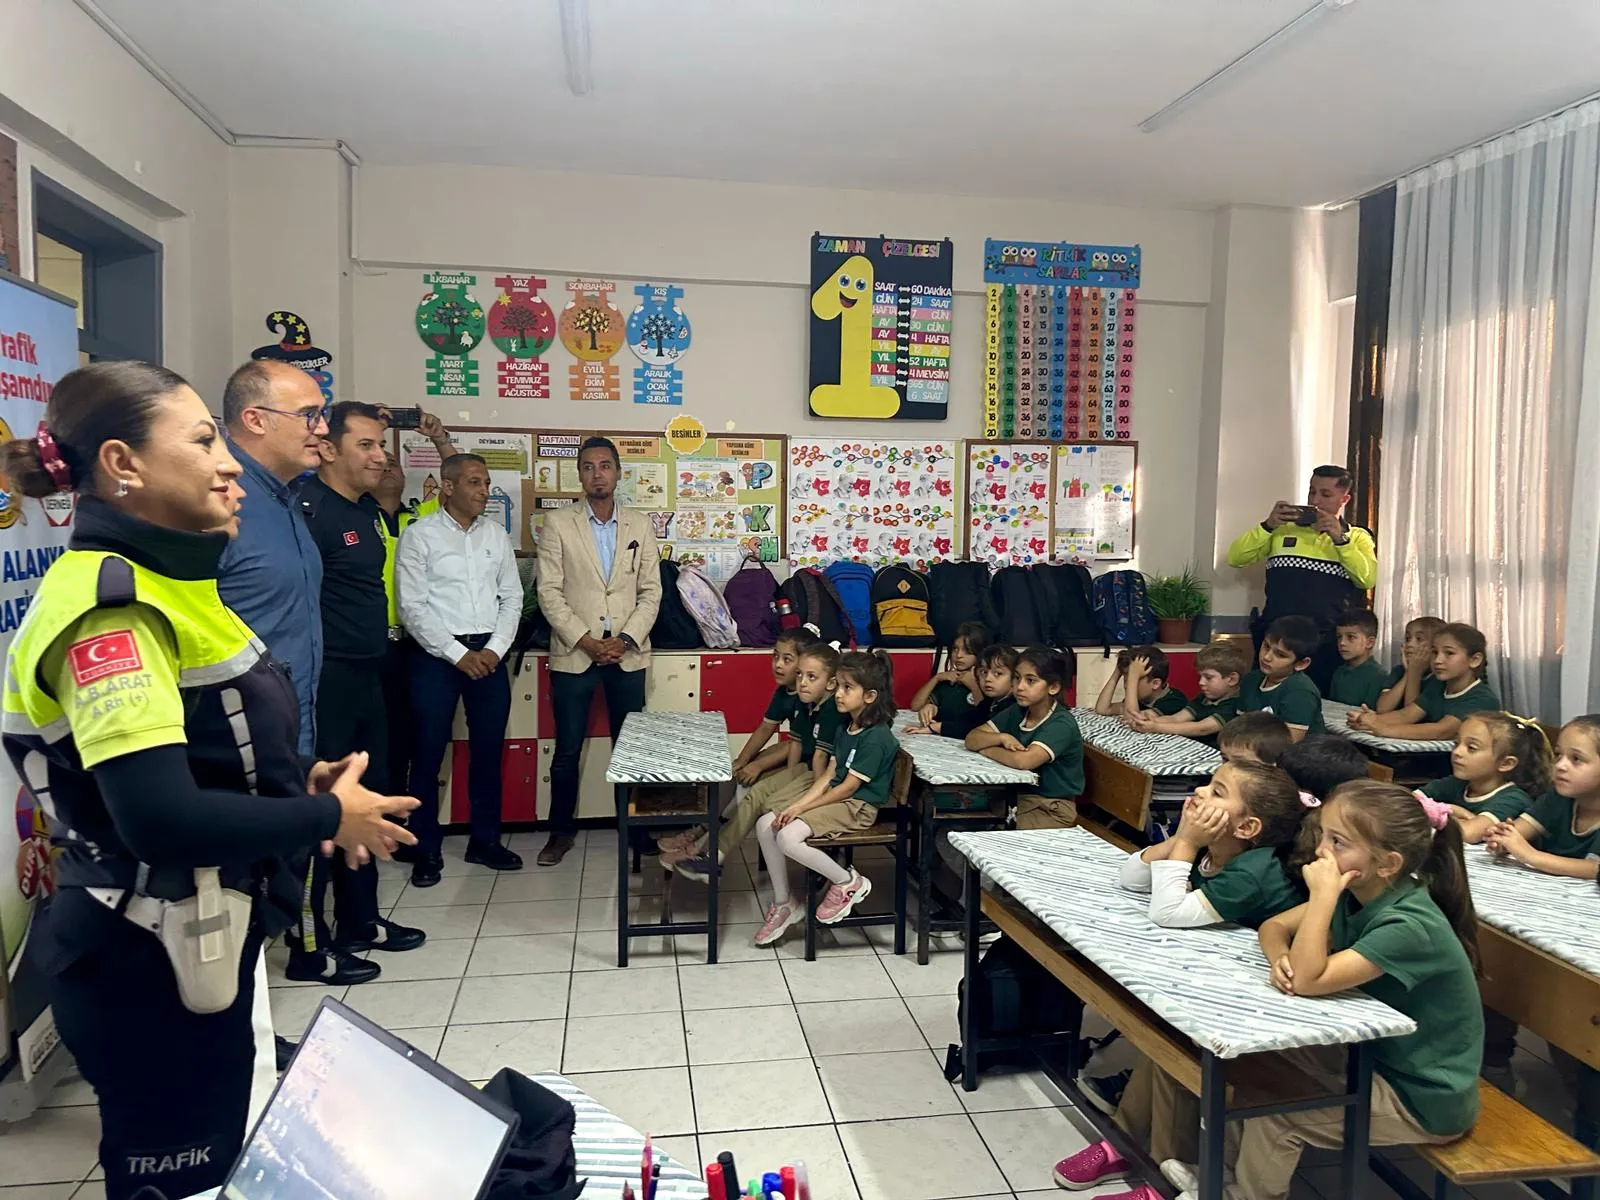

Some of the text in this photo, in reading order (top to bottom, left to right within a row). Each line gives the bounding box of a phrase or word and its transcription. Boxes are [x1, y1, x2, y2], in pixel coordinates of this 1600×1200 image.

[818, 239, 940, 258] ZAMAN ÇİZELGESİ
[430, 274, 470, 285] İLKBAHAR
[512, 279, 529, 288] YAZ
[568, 282, 613, 291] SONBAHAR
[875, 282, 952, 296] SAAT 60 DAKİKA
[992, 289, 996, 297] 2
[1110, 292, 1115, 300] 9
[876, 294, 950, 308] GÜN 24 SAAT
[873, 305, 897, 315] HAFTA
[912, 310, 917, 318] 7
[991, 304, 996, 312] 4
[1024, 305, 1029, 313] 8
[1109, 308, 1115, 316] 18
[879, 318, 891, 327] AY
[927, 322, 944, 332] GÜN
[991, 320, 996, 328] 6
[1040, 321, 1046, 329] 15
[1107, 323, 1115, 331] 27
[1124, 324, 1133, 332] 30
[878, 329, 949, 344] AY 4 HAFTA
[1090, 339, 1098, 347] 32
[1106, 339, 1115, 347] 36
[878, 352, 947, 367] YIL 52 HAFTA
[989, 352, 996, 360] 10
[1039, 352, 1047, 360] 25
[1106, 354, 1115, 362] 45
[440, 360, 464, 369] MART
[506, 361, 542, 372] HAZİRAN
[583, 365, 606, 374] EYLÜL
[440, 372, 465, 382] NİSAN
[644, 369, 672, 378] ARALIK
[877, 364, 949, 380] YIL 4 MEVSİM
[1105, 370, 1114, 378] 54
[505, 376, 542, 385] TEMMUZ
[585, 377, 605, 387] EKİM
[909, 380, 924, 389] 365
[440, 386, 467, 395] MAYIS
[647, 382, 669, 391] OCAK
[989, 383, 996, 391] 14
[1088, 385, 1096, 393] 56
[1120, 385, 1129, 393] 70
[583, 391, 609, 400] KASIM
[922, 392, 942, 400] SAAT
[989, 398, 996, 406] 16
[989, 413, 996, 421] 18
[1021, 413, 1030, 421] 36
[1106, 415, 1112, 423] 81
[672, 429, 701, 438] BESİNLER
[1105, 430, 1114, 438] 90
[752, 462, 772, 489] P
[750, 505, 771, 532] K
[648, 512, 675, 539] Y
[127, 1146, 212, 1174] TRAFİK
